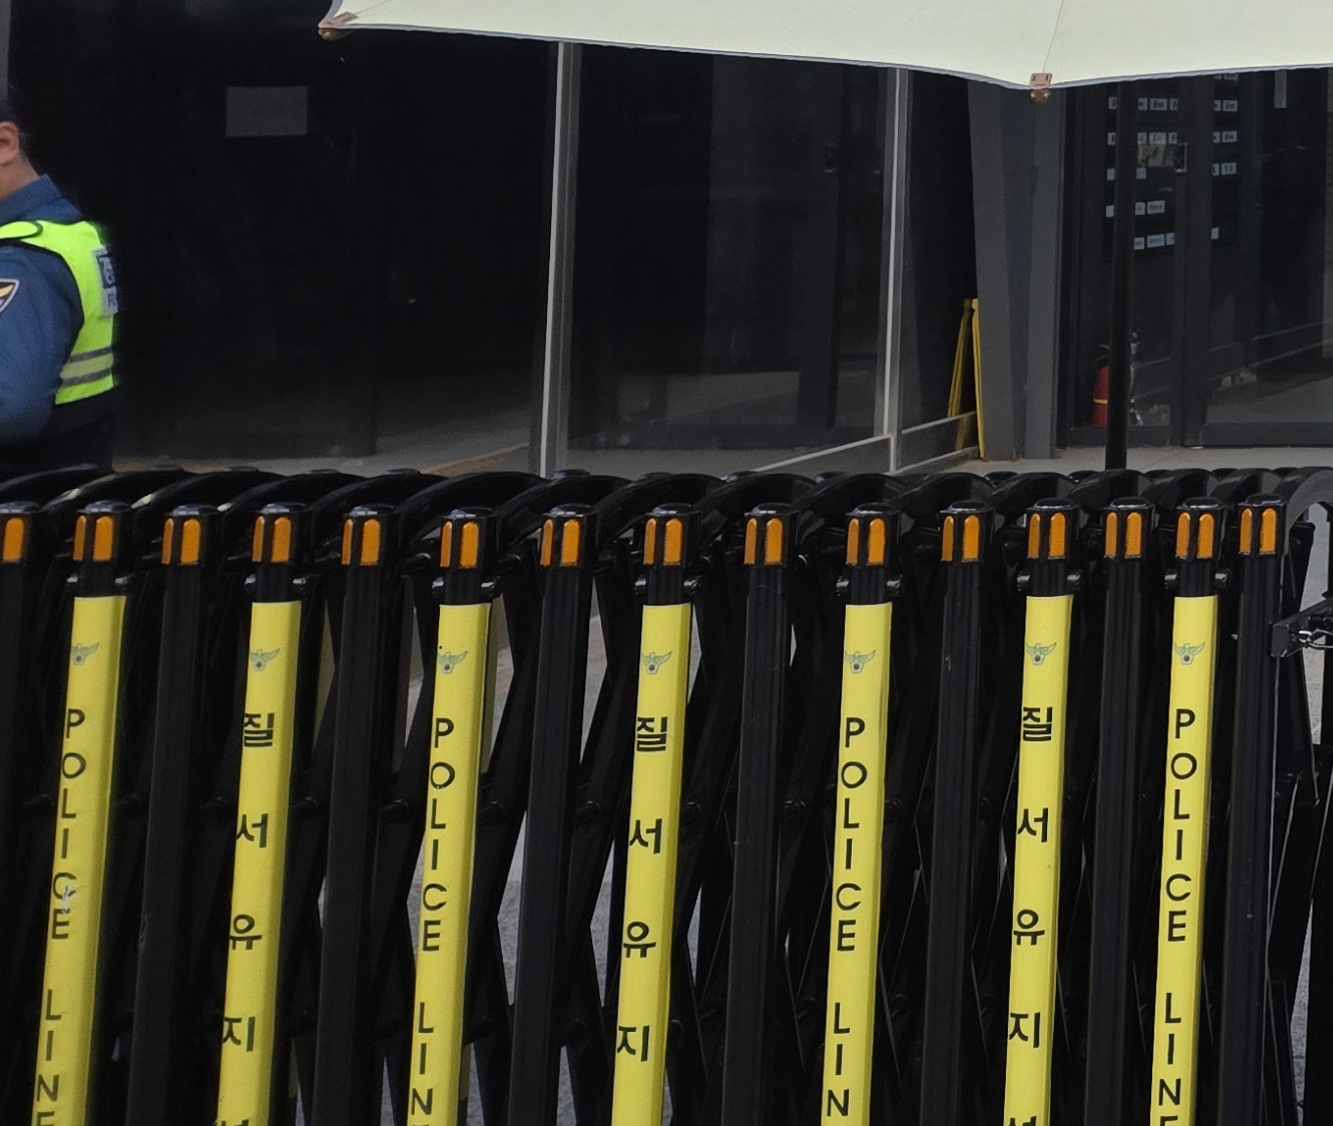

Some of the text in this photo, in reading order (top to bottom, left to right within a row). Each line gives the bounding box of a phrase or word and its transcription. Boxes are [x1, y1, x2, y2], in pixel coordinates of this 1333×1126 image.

[51, 708, 86, 940] POLICE
[214, 712, 276, 1126] 질서유지
[410, 717, 455, 1126] POLICE LIN
[616, 716, 669, 1062] 질서유지
[826, 717, 868, 1117] POLICE LIN
[1006, 707, 1054, 1126] 질서유지
[1167, 708, 1198, 942] POLICE
